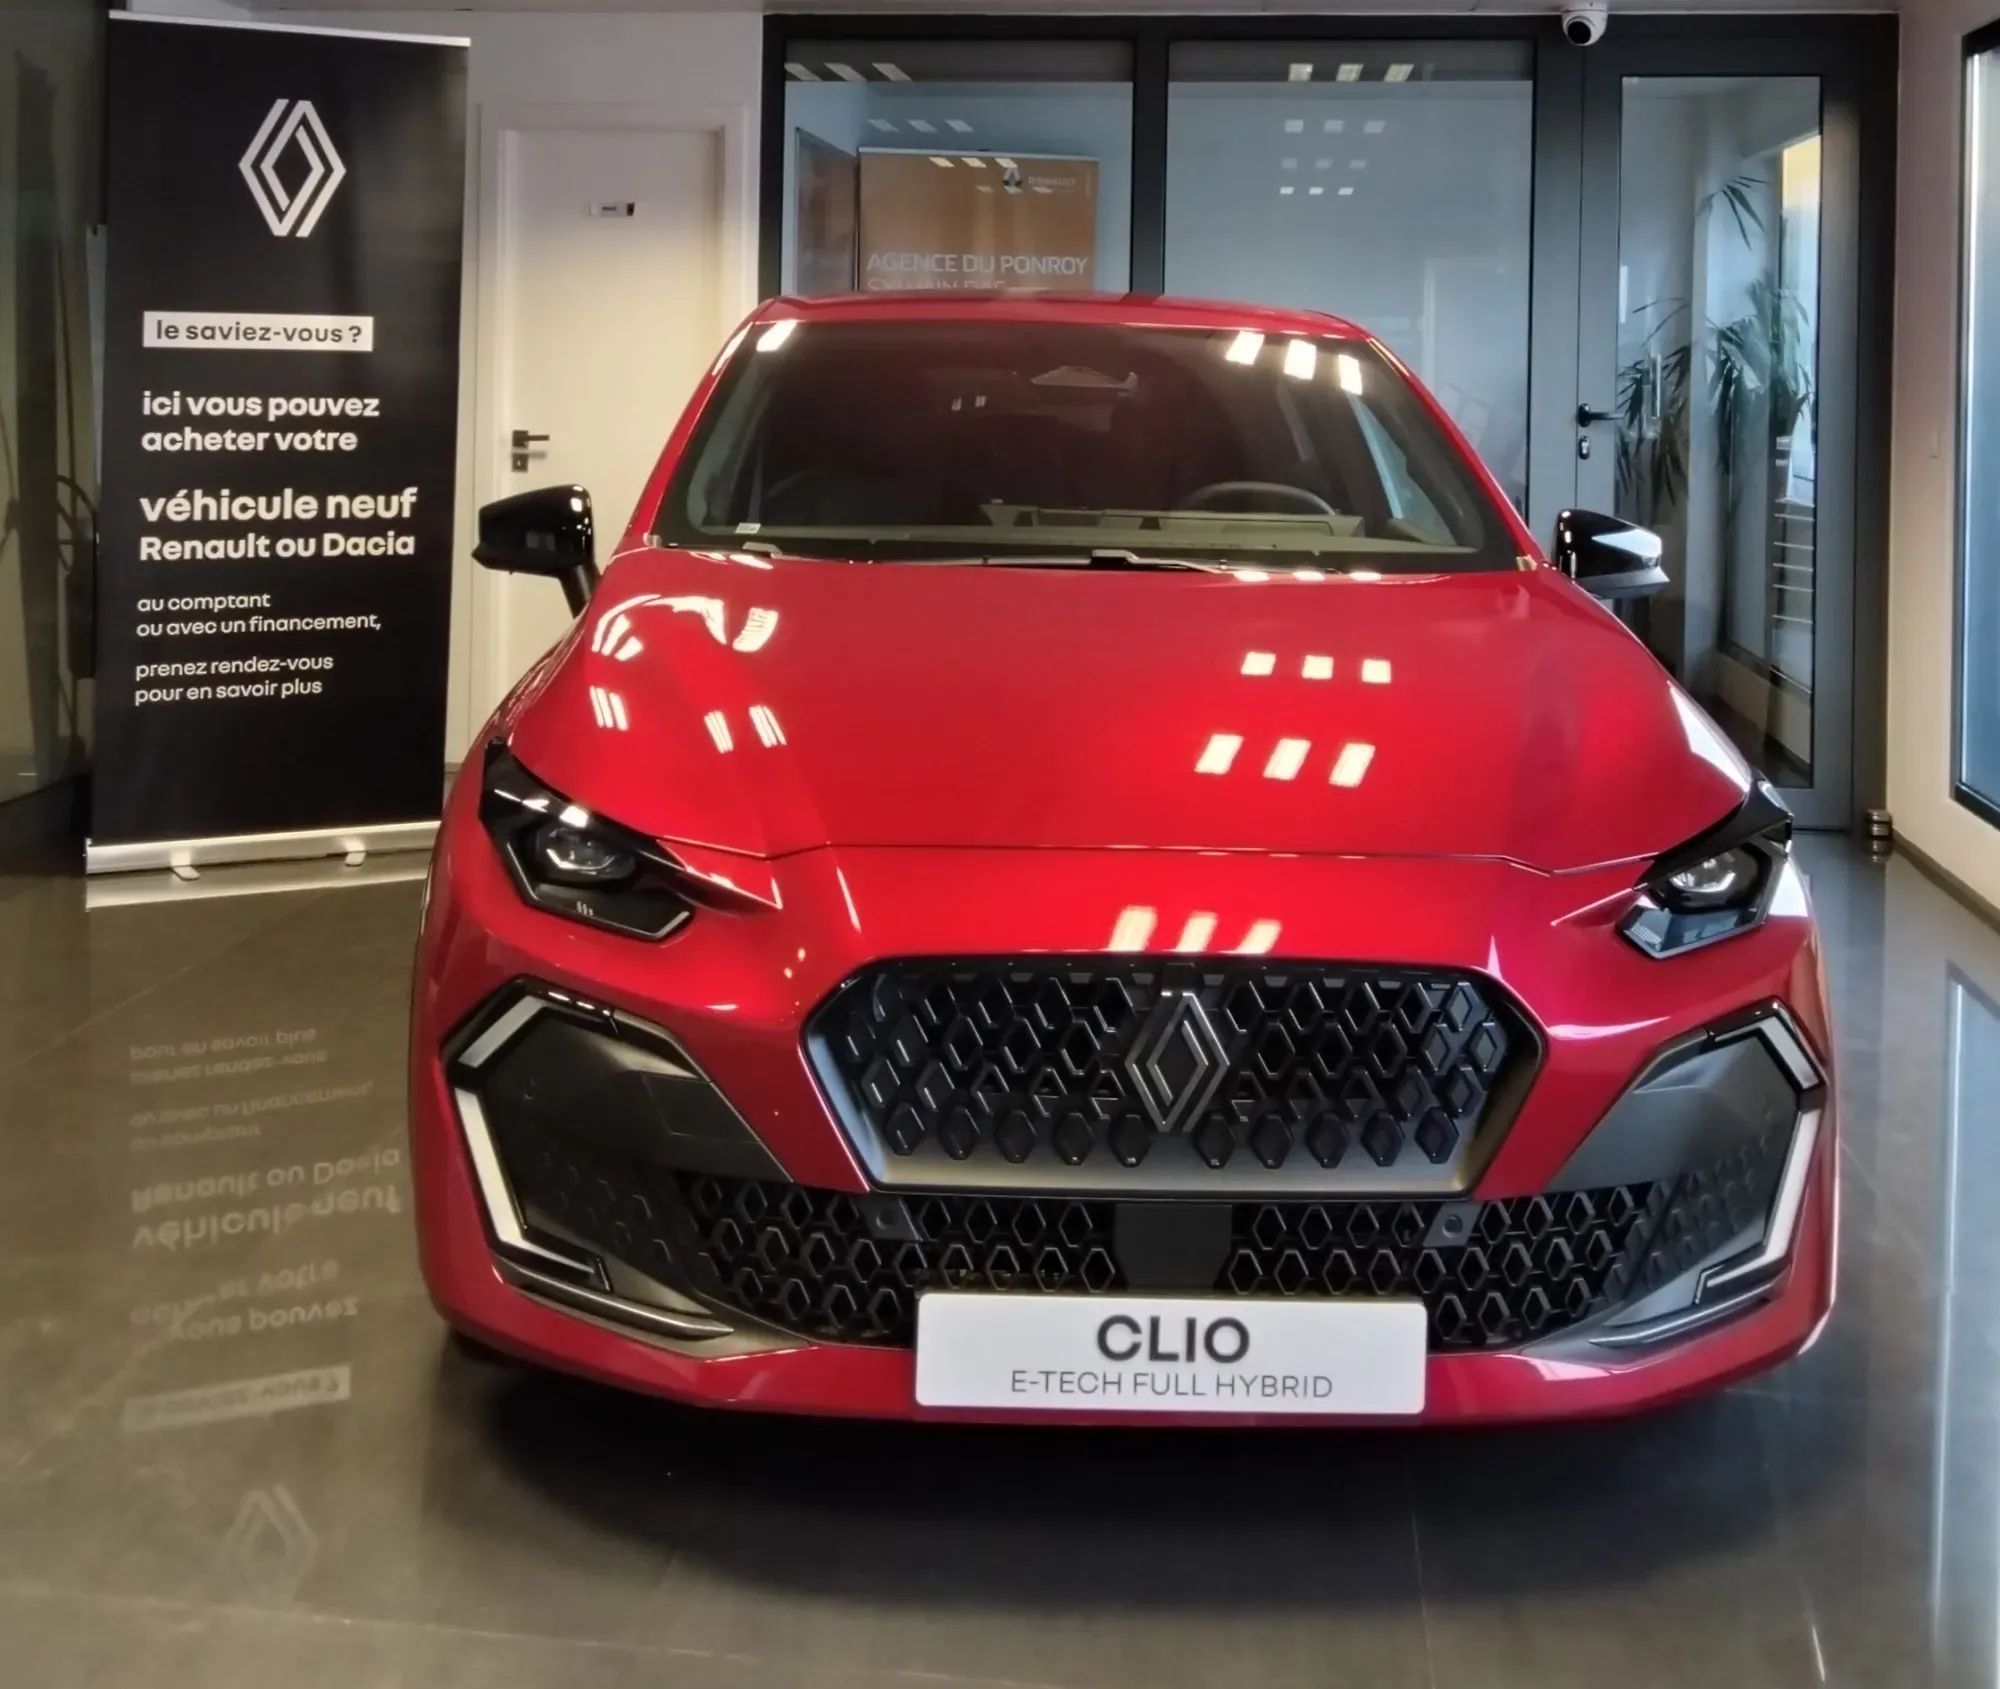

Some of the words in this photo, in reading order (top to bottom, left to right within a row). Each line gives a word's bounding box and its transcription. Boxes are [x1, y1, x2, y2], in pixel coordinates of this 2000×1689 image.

[866, 253, 958, 272] AGENCE
[962, 253, 996, 273] DU
[1000, 255, 1089, 275] PONROY
[156, 319, 180, 340] le
[186, 321, 343, 343] saviez-vous
[348, 325, 363, 344] ?
[142, 390, 181, 416] ici
[186, 396, 263, 416] vous
[268, 397, 380, 422] pouvez
[141, 427, 270, 452] acheter
[275, 429, 358, 451] votre
[140, 488, 318, 521] véhicule
[326, 487, 418, 518] neuf
[139, 533, 271, 561] Renault
[275, 537, 316, 558] ou
[322, 531, 415, 557] Dacia
[137, 598, 166, 612] au
[168, 593, 271, 613] comptant
[136, 622, 164, 637] ou
[166, 621, 217, 635] avec
[220, 619, 246, 634] un
[249, 613, 382, 633] financement,
[135, 660, 207, 681] prenez
[211, 655, 334, 675] rendez-vous
[134, 686, 184, 707] pour
[186, 685, 212, 700] en
[216, 681, 278, 699] savoir
[281, 678, 323, 699] plus
[1096, 1314, 1251, 1364] CLIO
[1010, 1369, 1123, 1395] E-TECH
[1132, 1372, 1207, 1397] FULL
[1215, 1374, 1334, 1399] HYBRID
